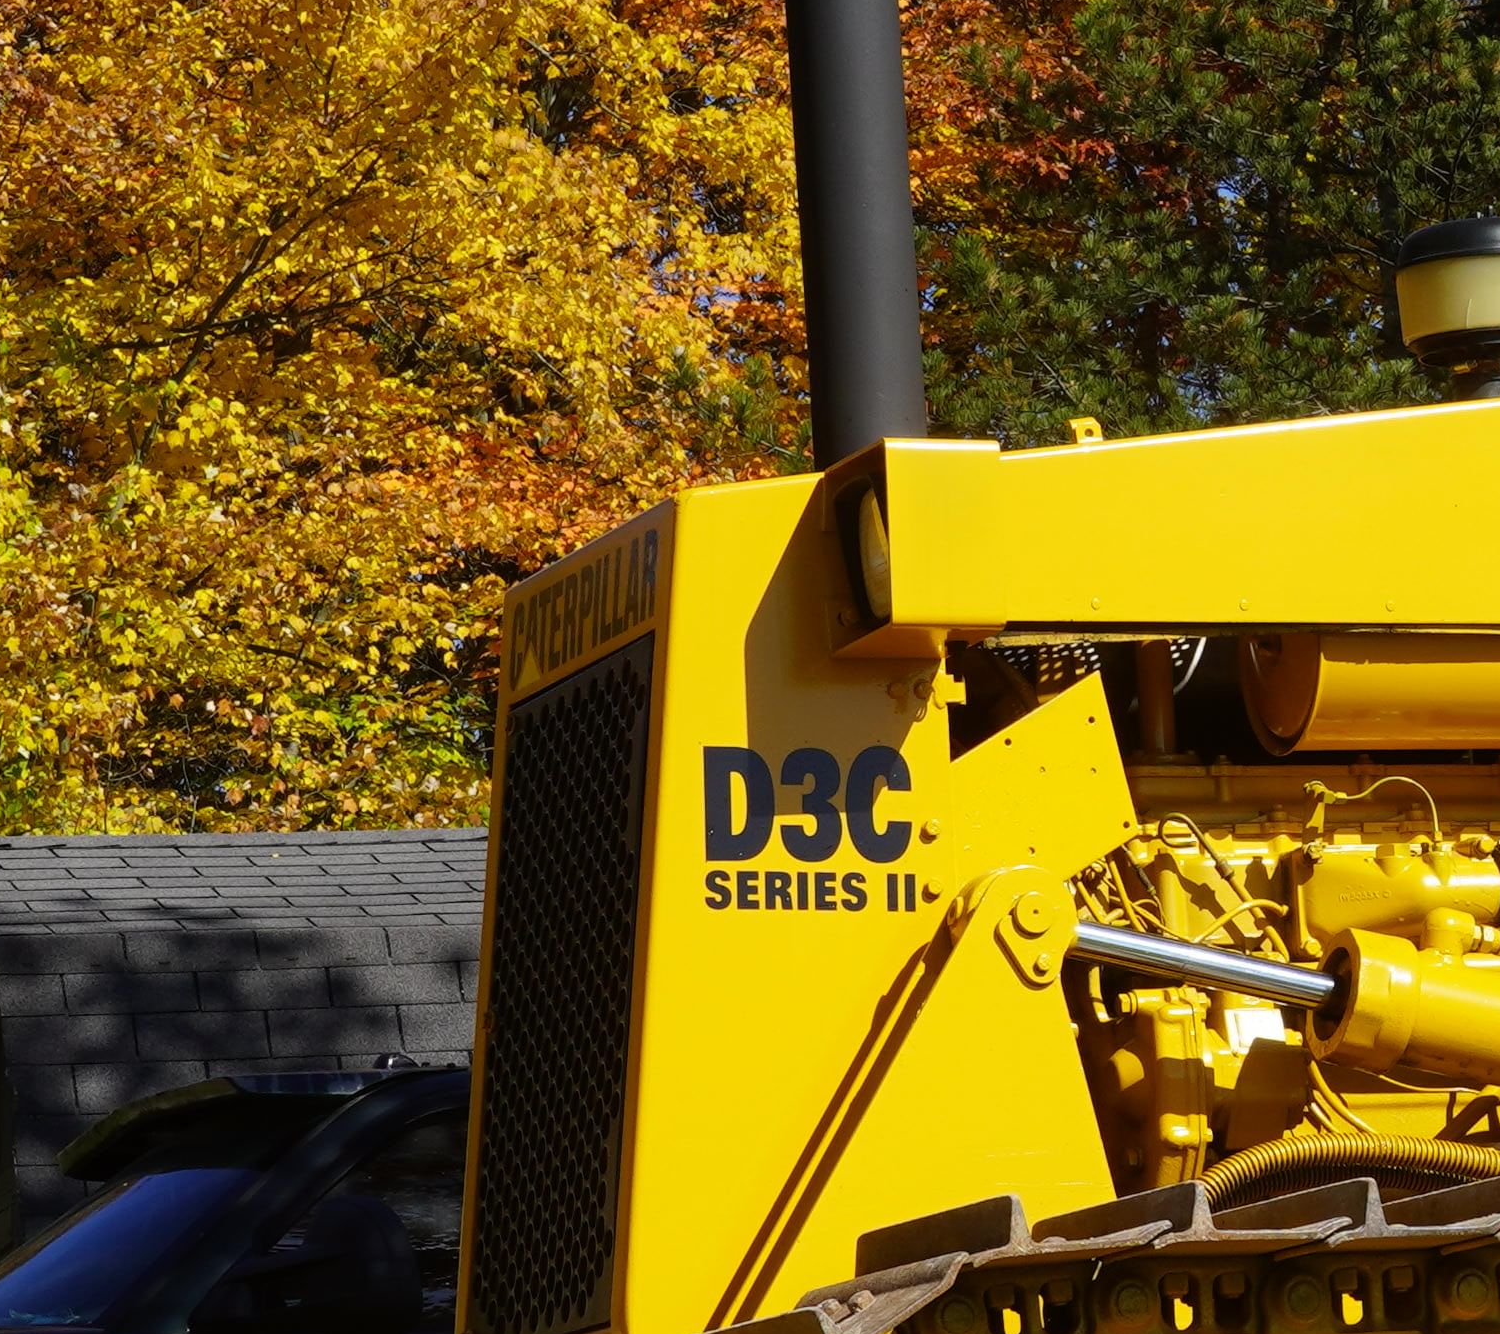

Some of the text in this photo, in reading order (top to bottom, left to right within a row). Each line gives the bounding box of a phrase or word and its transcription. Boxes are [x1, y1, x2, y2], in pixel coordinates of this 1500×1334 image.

[510, 529, 658, 692] CATERPILLAR
[703, 745, 913, 864] D3C
[703, 870, 918, 913] SERIES II
